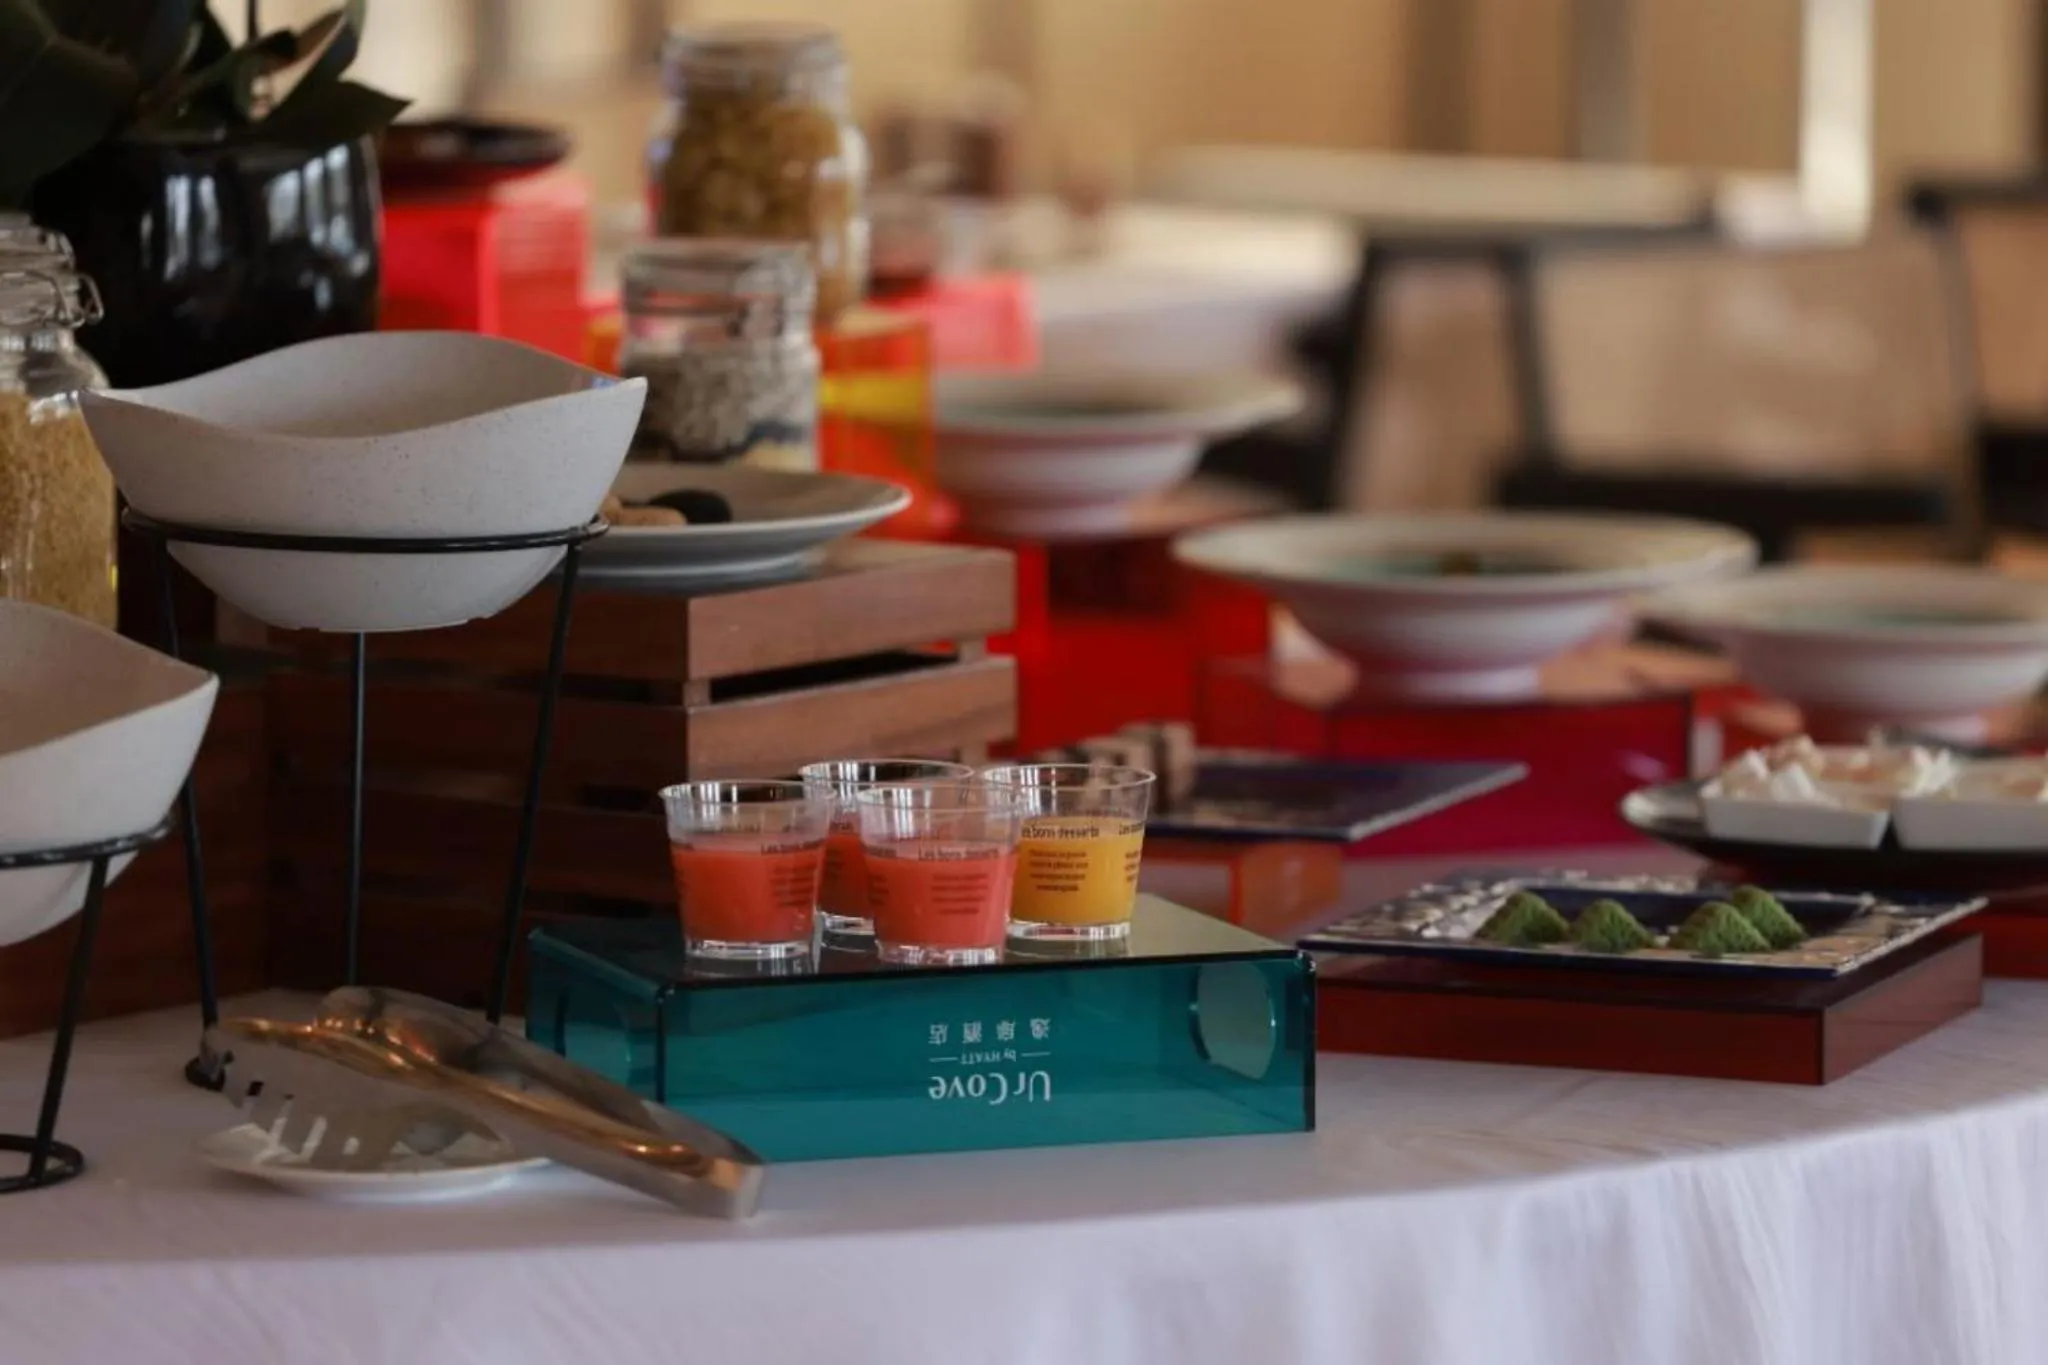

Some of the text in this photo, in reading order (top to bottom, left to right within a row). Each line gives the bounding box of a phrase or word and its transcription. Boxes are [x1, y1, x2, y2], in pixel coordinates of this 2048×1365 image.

[960, 1047, 1017, 1065] by HYATT
[928, 1069, 1051, 1106] UrCove
